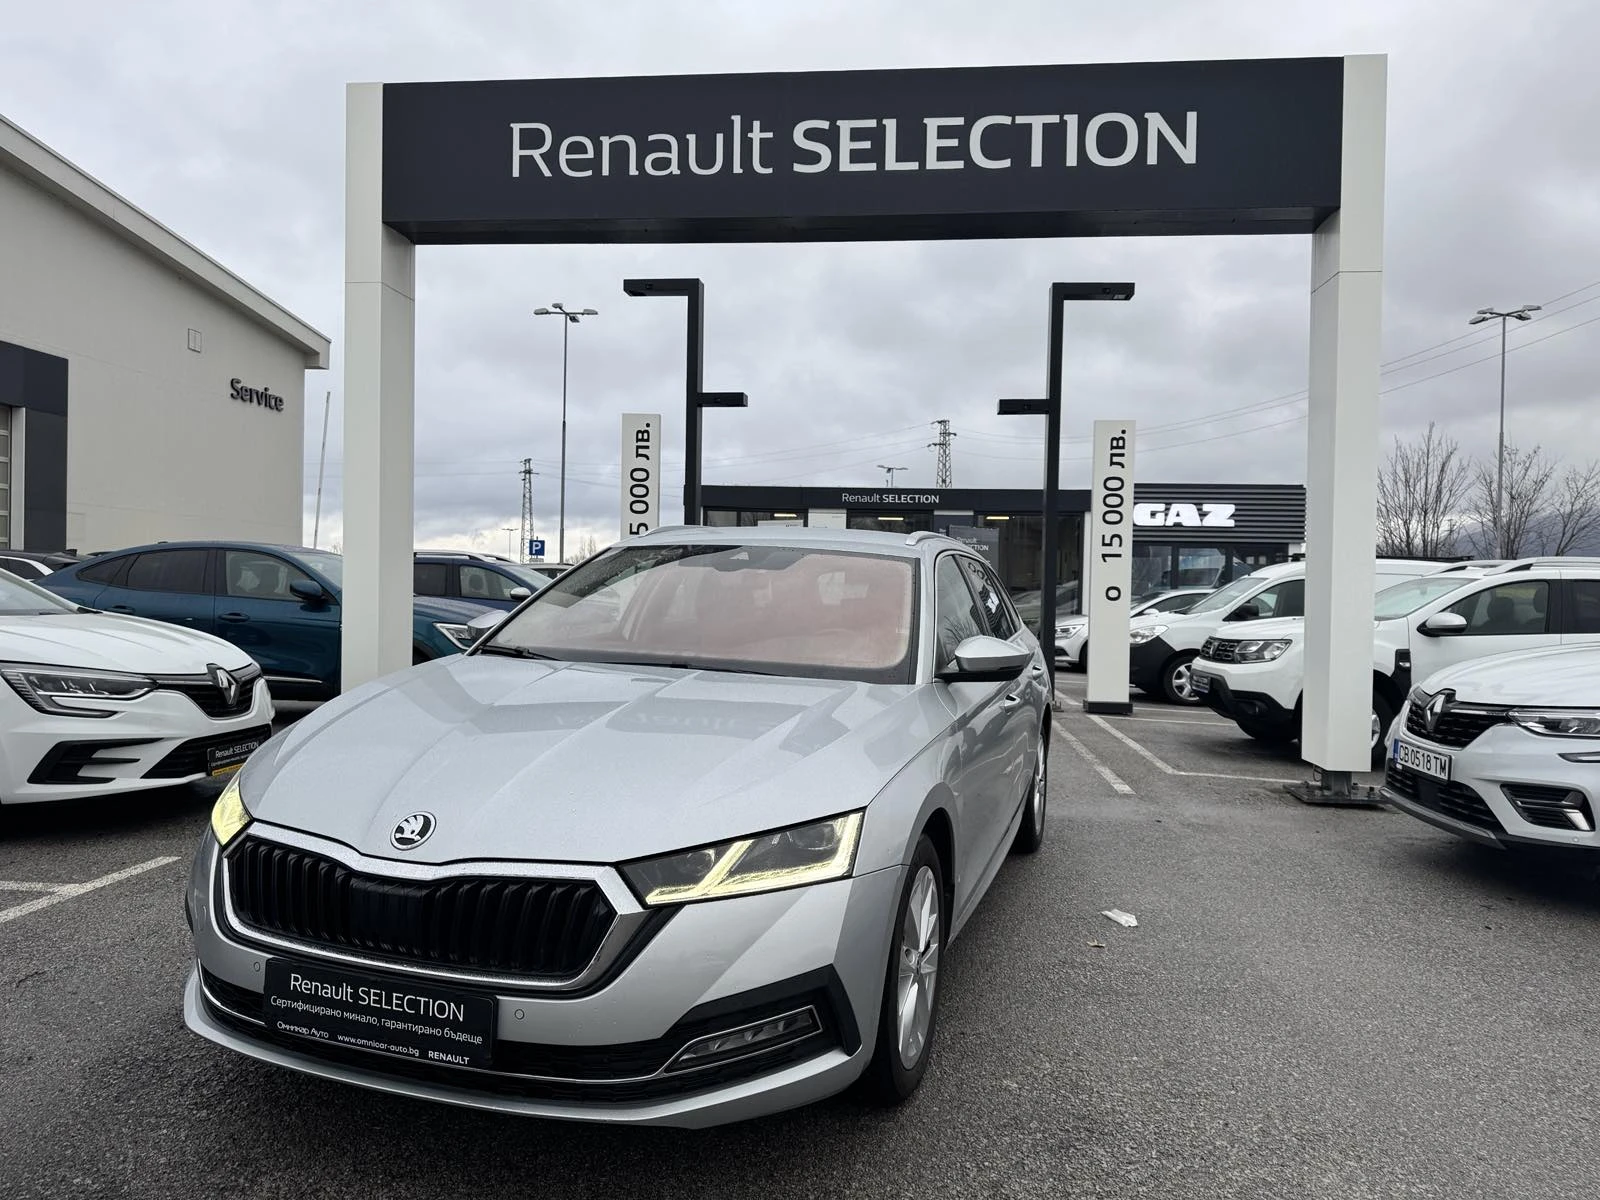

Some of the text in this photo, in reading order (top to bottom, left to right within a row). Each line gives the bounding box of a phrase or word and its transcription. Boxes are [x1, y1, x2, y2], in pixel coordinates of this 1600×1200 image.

[509, 111, 1198, 178] Renault SELECTION
[230, 377, 284, 412] Service
[635, 422, 651, 461] лв.
[1109, 428, 1127, 468] лв.
[629, 467, 650, 515] 000
[841, 493, 940, 504] Renault SELECTION
[1102, 476, 1125, 525] 000
[1133, 502, 1236, 527] GAZ
[532, 541, 542, 554] P
[1101, 533, 1123, 563] 15
[290, 973, 464, 1022] Renault SELECTION
[270, 995, 483, 1044] Сертифицирано минало, гарантирано бъдеще
[337, 1034, 420, 1057] www.omnicar-auto.bg
[428, 1050, 470, 1065] RENAULT
